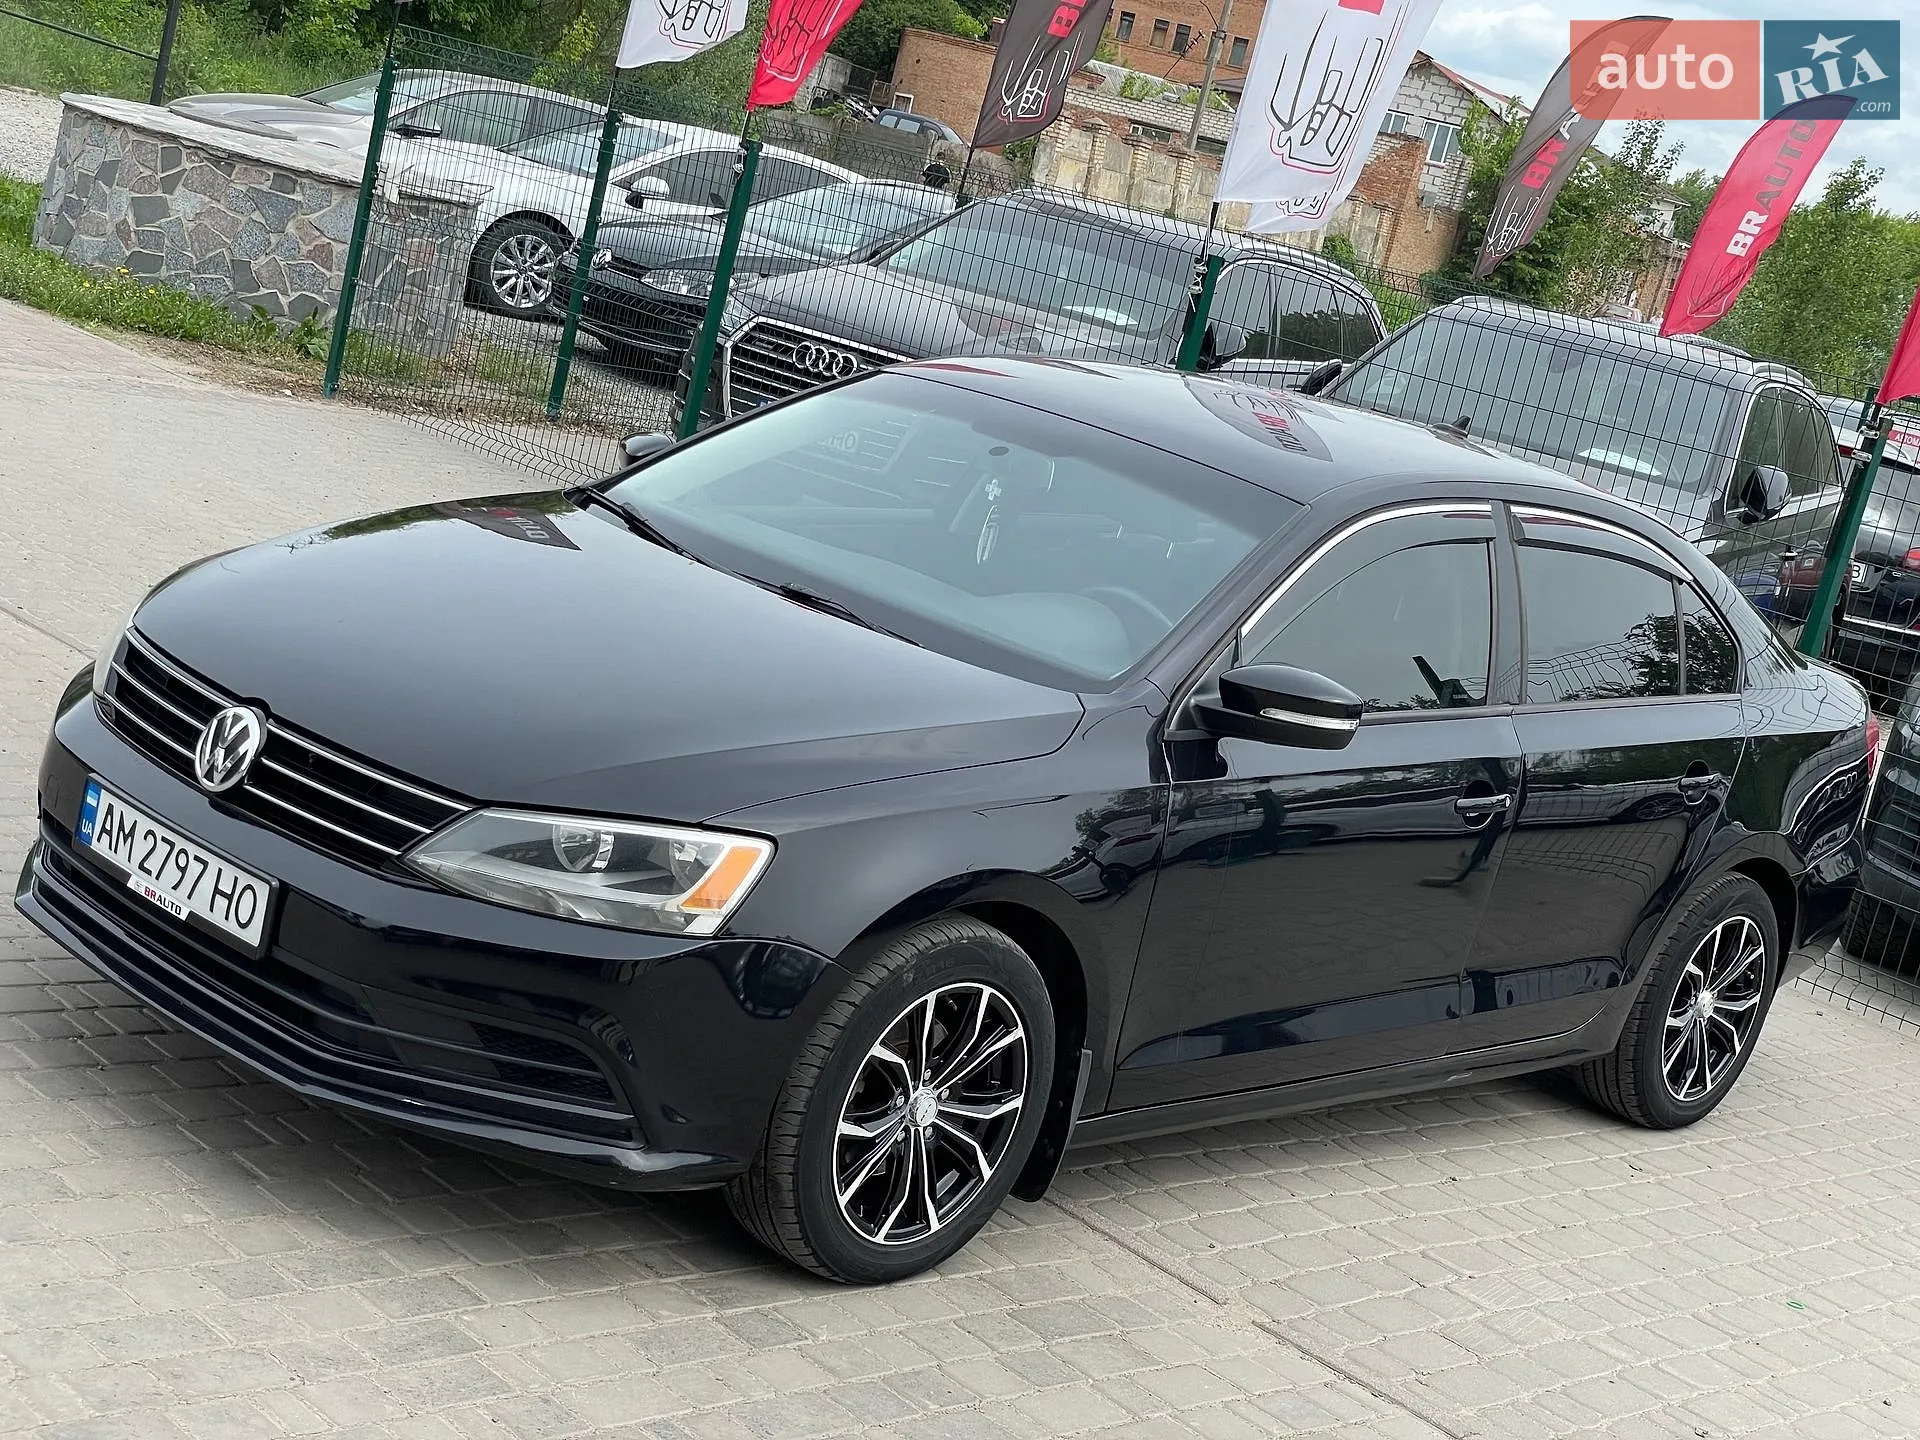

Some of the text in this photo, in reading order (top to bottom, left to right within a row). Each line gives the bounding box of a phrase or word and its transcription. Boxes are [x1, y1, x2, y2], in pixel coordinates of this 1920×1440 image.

[1725, 118, 1819, 257] BRAUTO
[81, 818, 93, 836] UA
[96, 802, 258, 930] AM 2797 HO
[143, 885, 183, 916] BRAUTO
